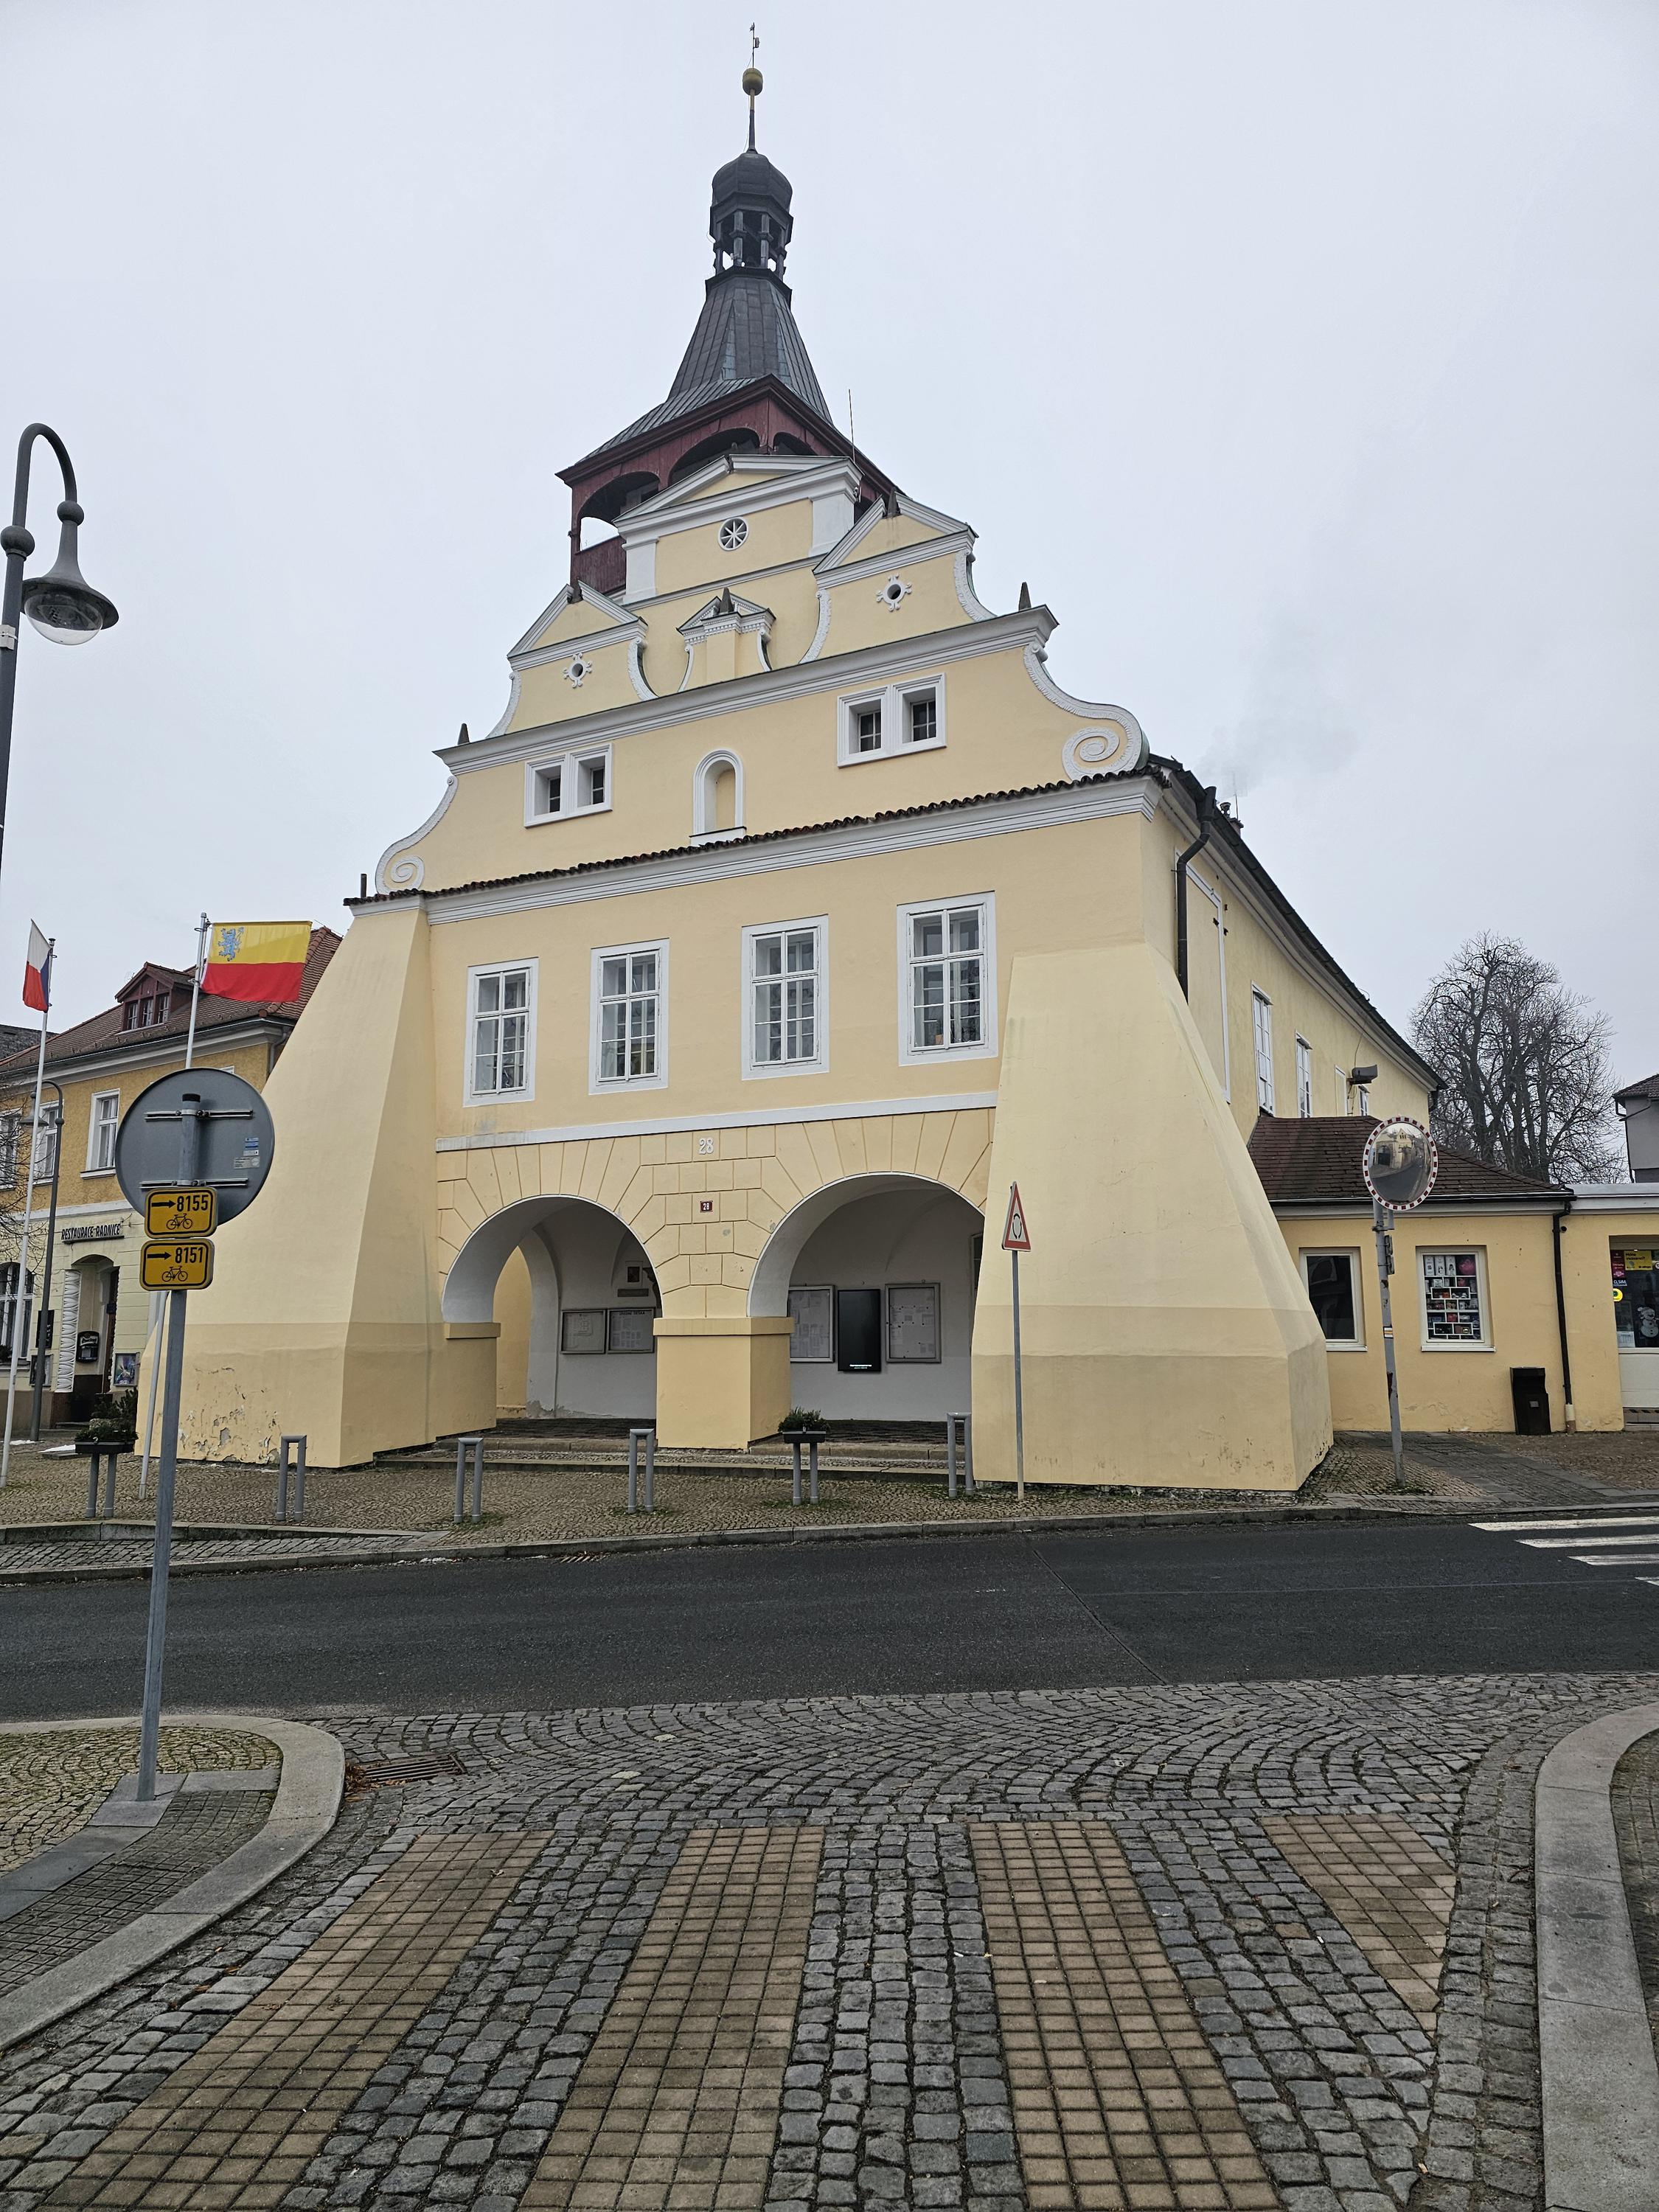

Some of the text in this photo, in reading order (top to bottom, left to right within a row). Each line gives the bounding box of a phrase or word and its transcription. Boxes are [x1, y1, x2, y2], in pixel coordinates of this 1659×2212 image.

[698, 1137, 714, 1155] 28
[176, 1194, 209, 1212] 8155
[703, 1203, 710, 1211] 28
[61, 1223, 121, 1240] RESTAURACE RADNICE
[175, 1246, 204, 1264] 8151
